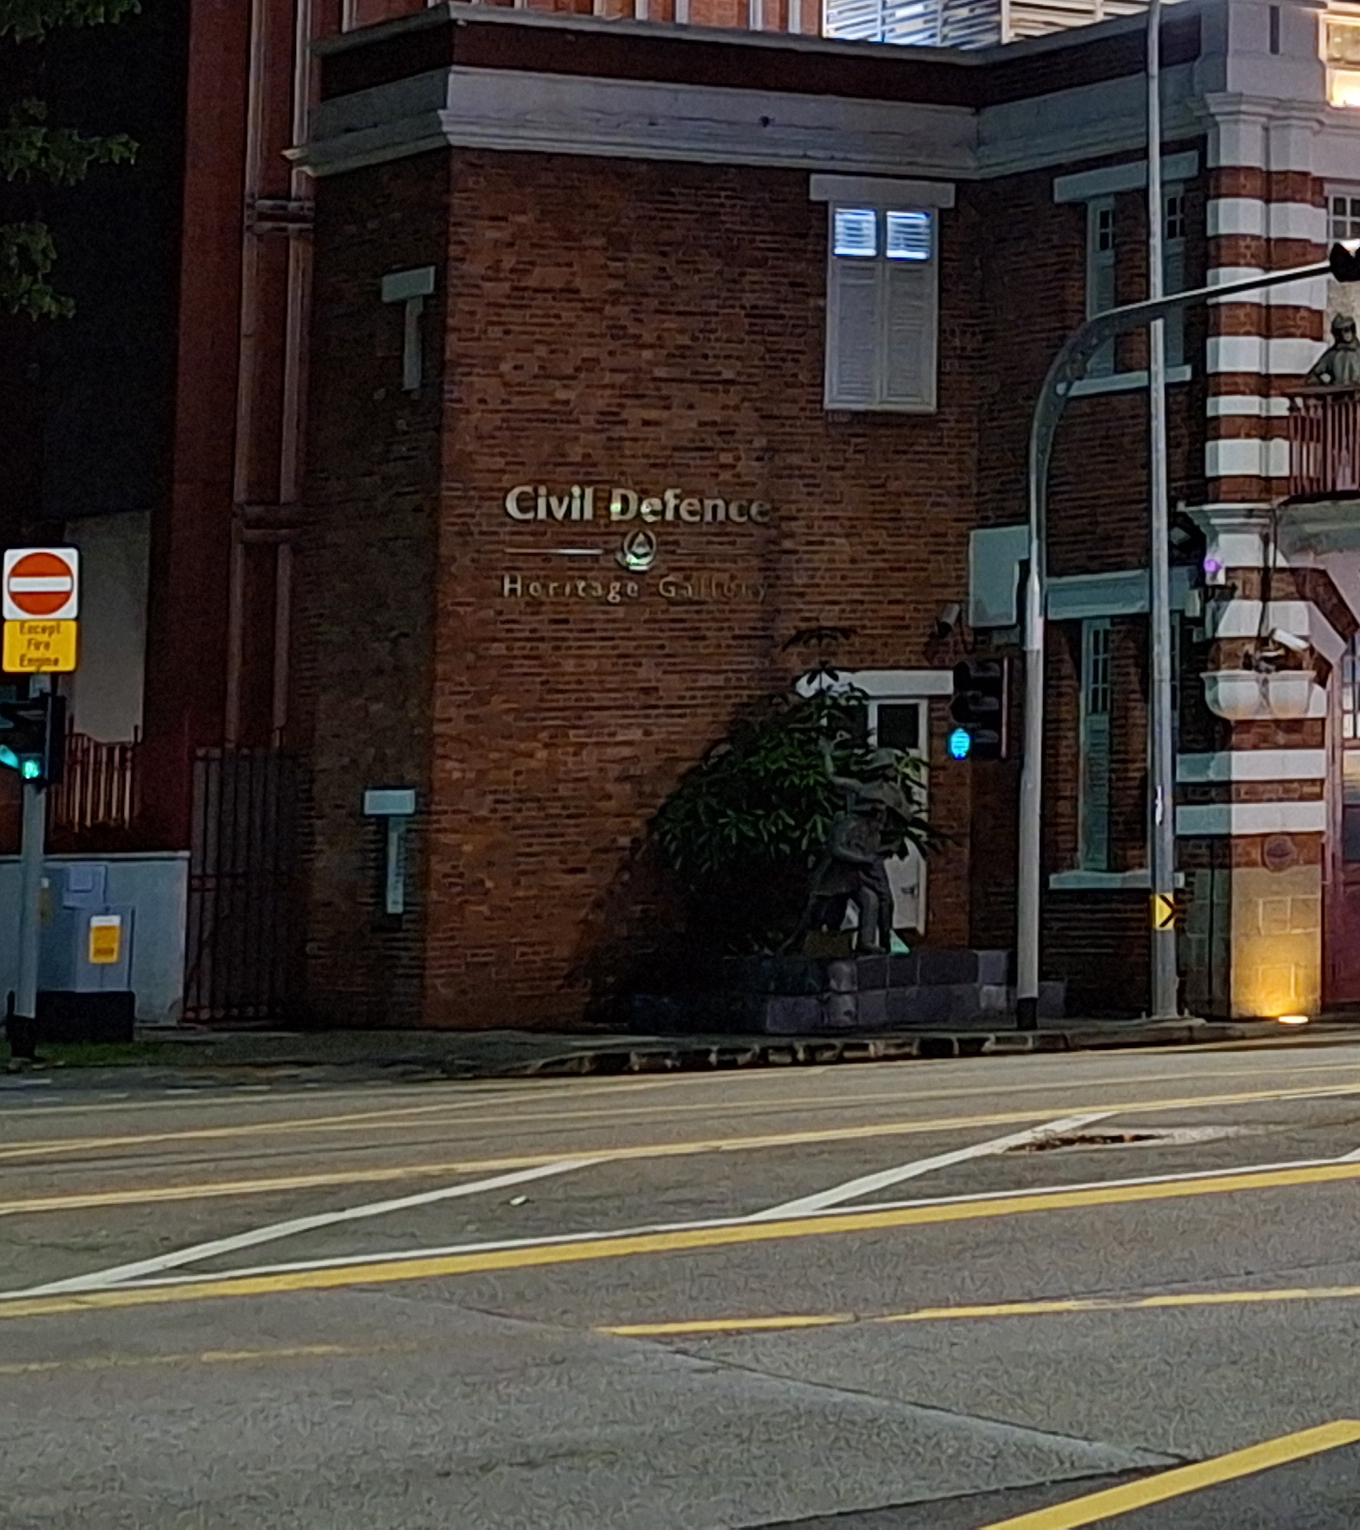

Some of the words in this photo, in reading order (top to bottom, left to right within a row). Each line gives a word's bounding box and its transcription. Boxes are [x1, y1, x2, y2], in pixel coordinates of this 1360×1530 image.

[505, 484, 594, 521] Civil
[609, 487, 772, 523] Defence
[503, 573, 639, 603] Heritage
[658, 575, 768, 602] Gallery
[19, 620, 61, 639] Except
[27, 638, 51, 651] Fire
[19, 654, 59, 670] Engine
